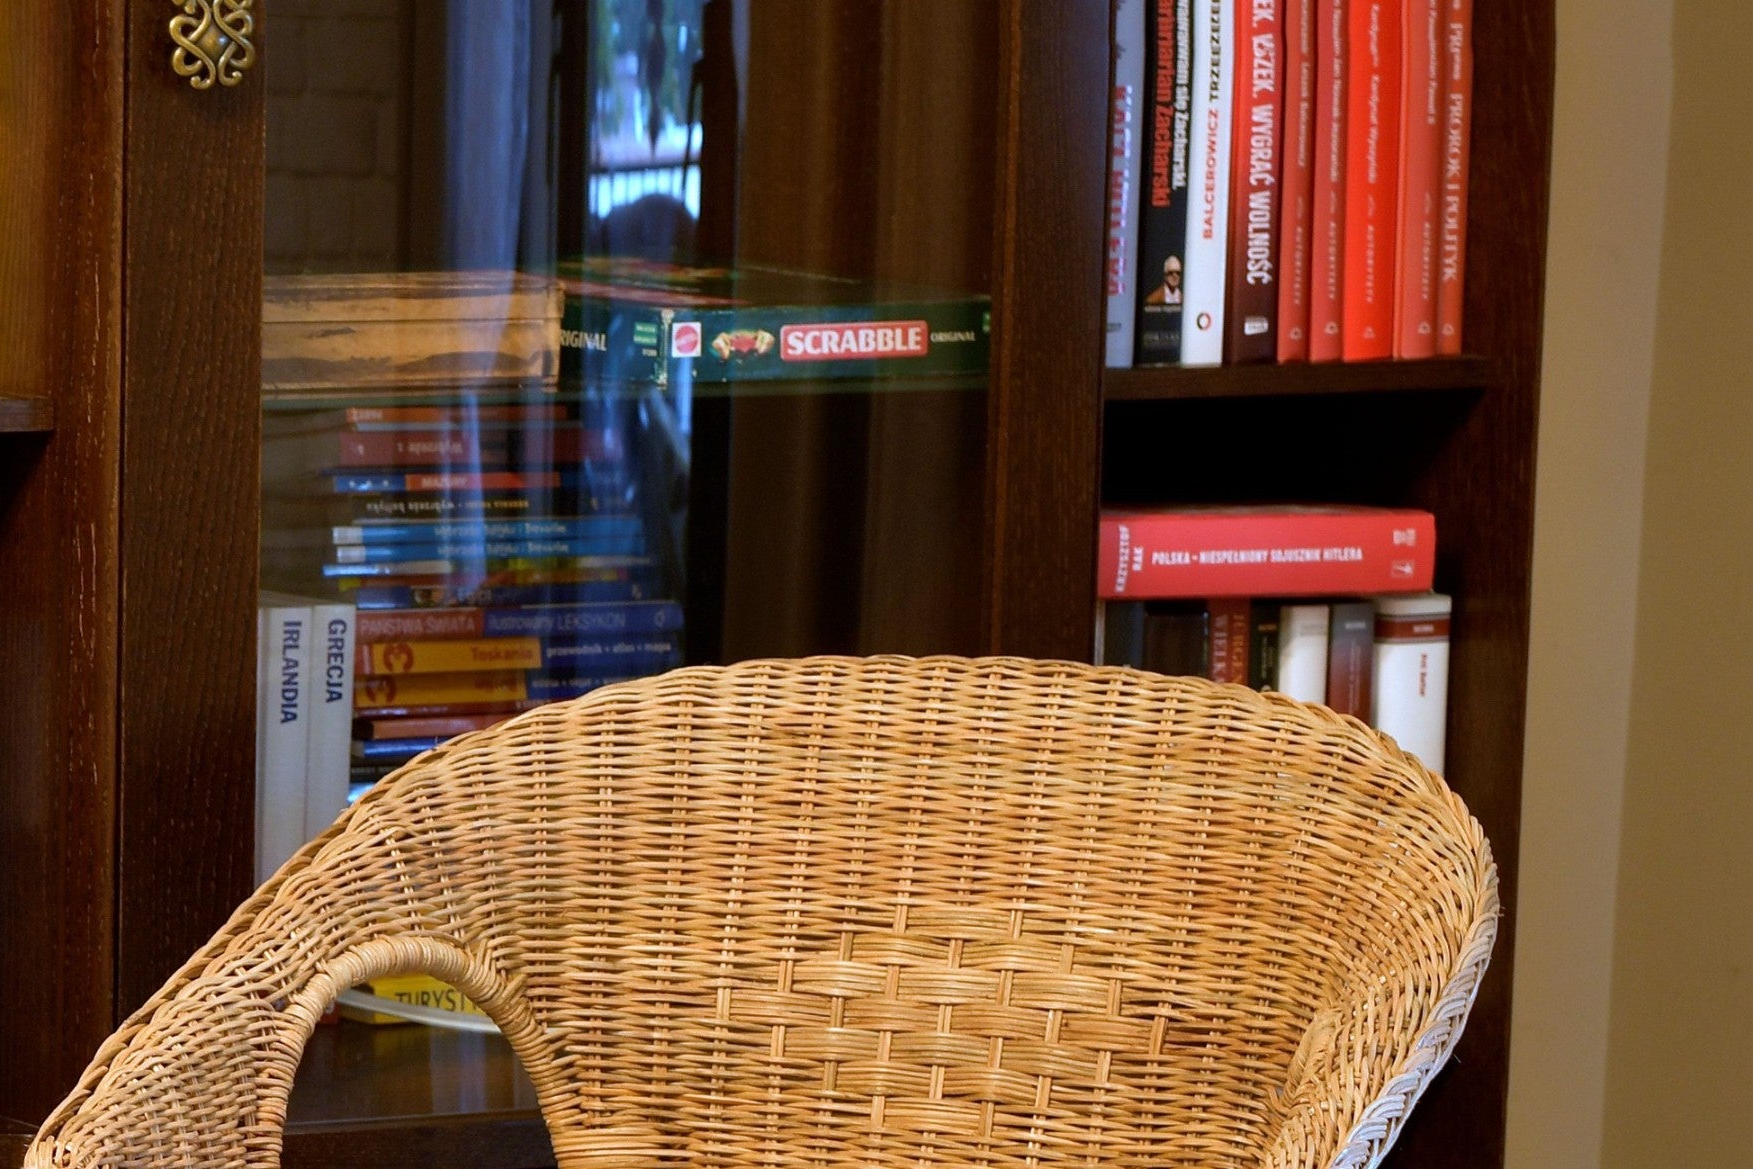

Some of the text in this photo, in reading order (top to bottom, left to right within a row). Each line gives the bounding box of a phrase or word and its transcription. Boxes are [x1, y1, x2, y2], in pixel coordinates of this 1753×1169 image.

[1151, 104, 1175, 207] Zacharski
[1202, 108, 1219, 240] BALCEROWICZ
[1249, 103, 1276, 187] WYGRAĆ
[1246, 190, 1273, 286] WOLNOŚĆ
[561, 329, 607, 352] RIGINAL
[786, 326, 923, 356] SCRABBLE
[930, 330, 976, 343] ORIGINAL
[1151, 551, 1191, 566] POLSKA
[1323, 547, 1363, 562] HITLERA
[280, 620, 302, 725] IRLANDIA
[326, 619, 347, 704] GRECJA
